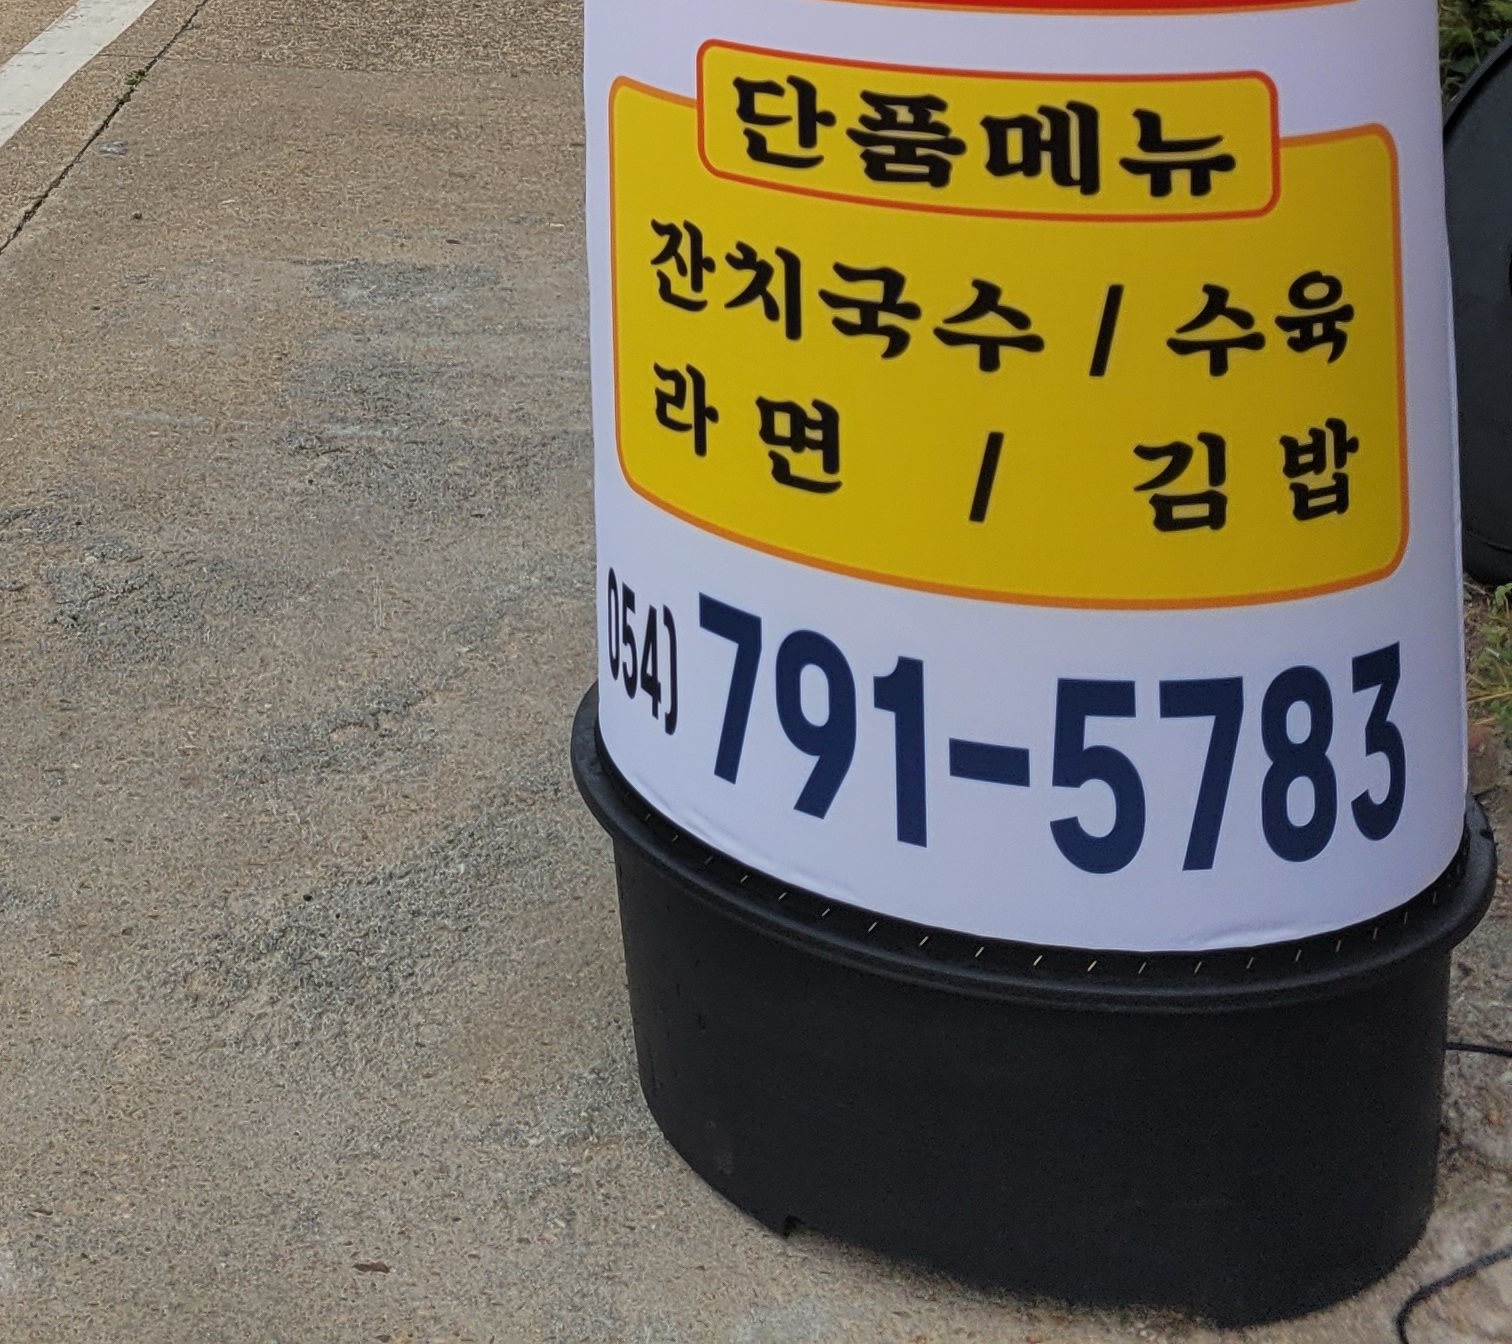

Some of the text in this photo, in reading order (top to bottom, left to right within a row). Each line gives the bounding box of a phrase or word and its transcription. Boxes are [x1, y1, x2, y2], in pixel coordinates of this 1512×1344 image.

[733, 75, 1236, 197] 단품메뉴
[650, 218, 1045, 373] 잔치국수
[1166, 269, 1355, 377] 수육
[699, 593, 1406, 875] 791-5783
